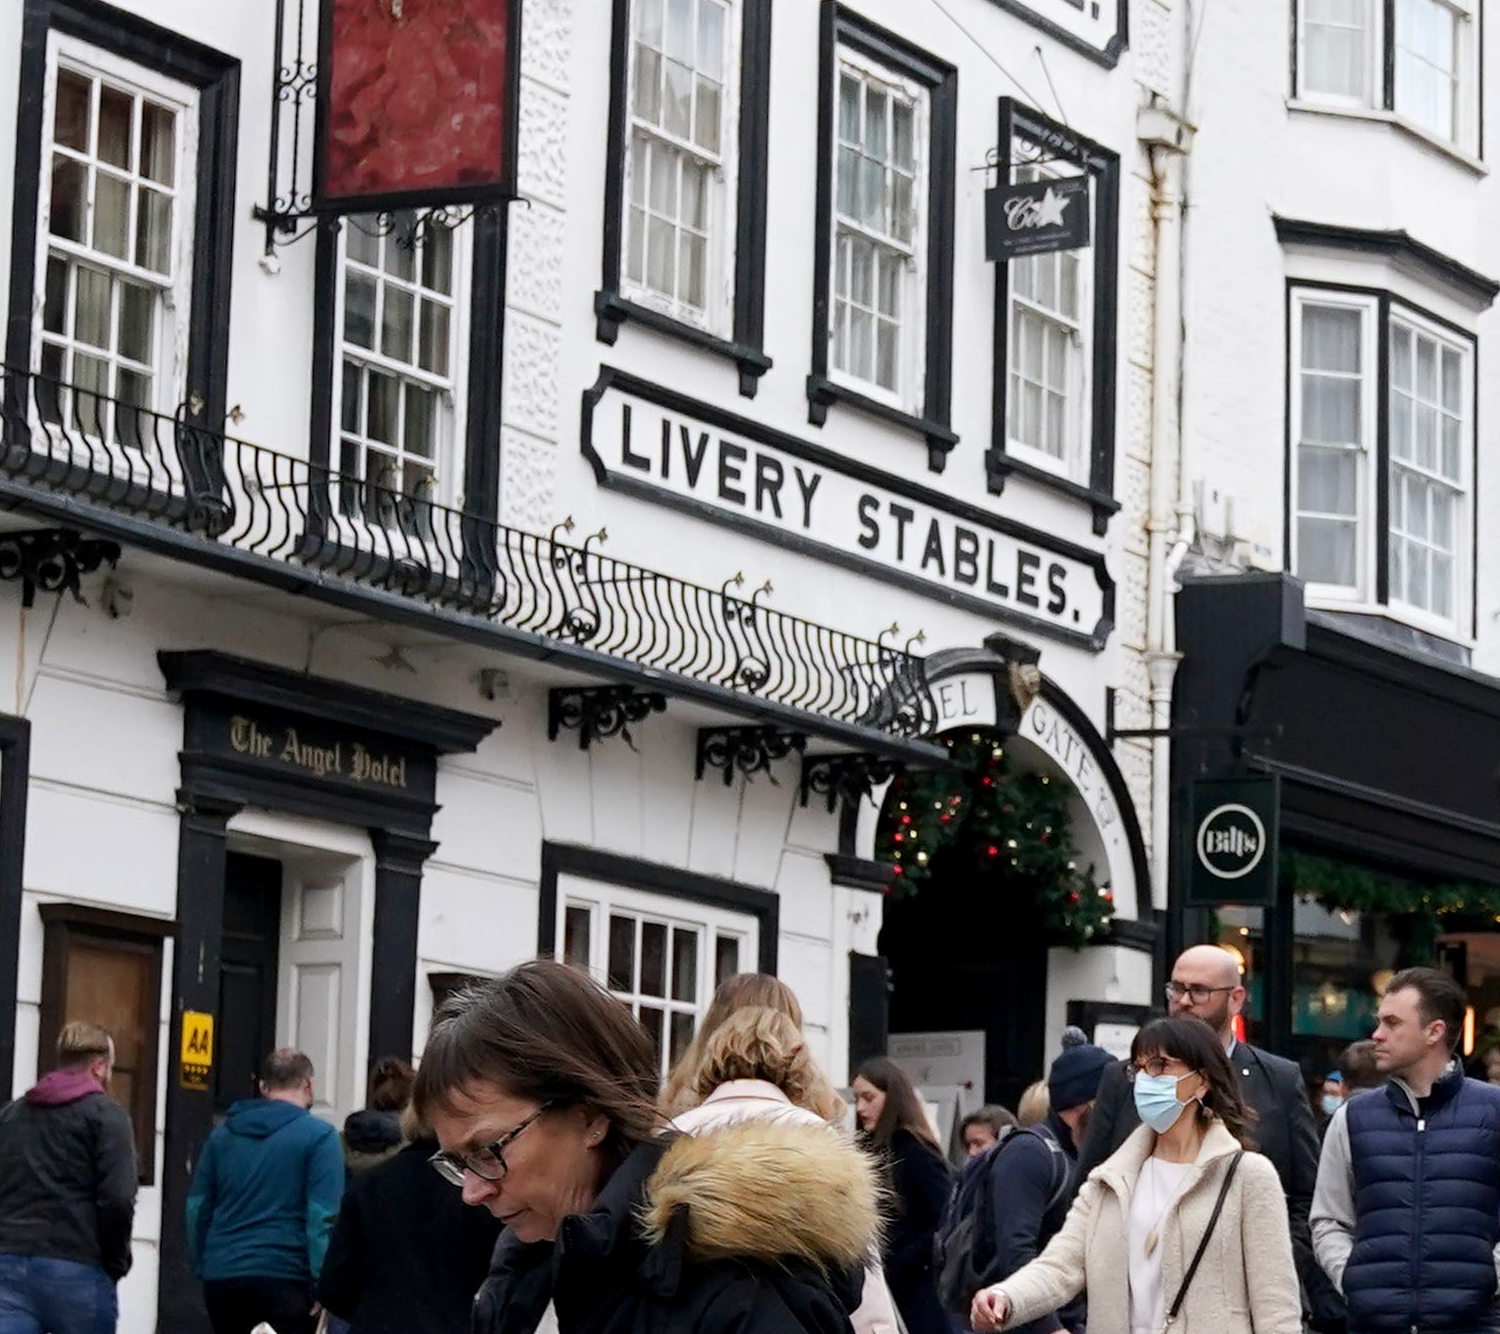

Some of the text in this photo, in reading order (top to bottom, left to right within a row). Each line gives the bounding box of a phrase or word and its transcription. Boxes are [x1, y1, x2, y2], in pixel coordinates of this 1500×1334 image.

[621, 403, 1081, 623] LIVERY STABLES.
[230, 715, 407, 788] The Angel Hotel
[1031, 704, 1095, 792] GATE
[187, 1028, 210, 1056] AA
